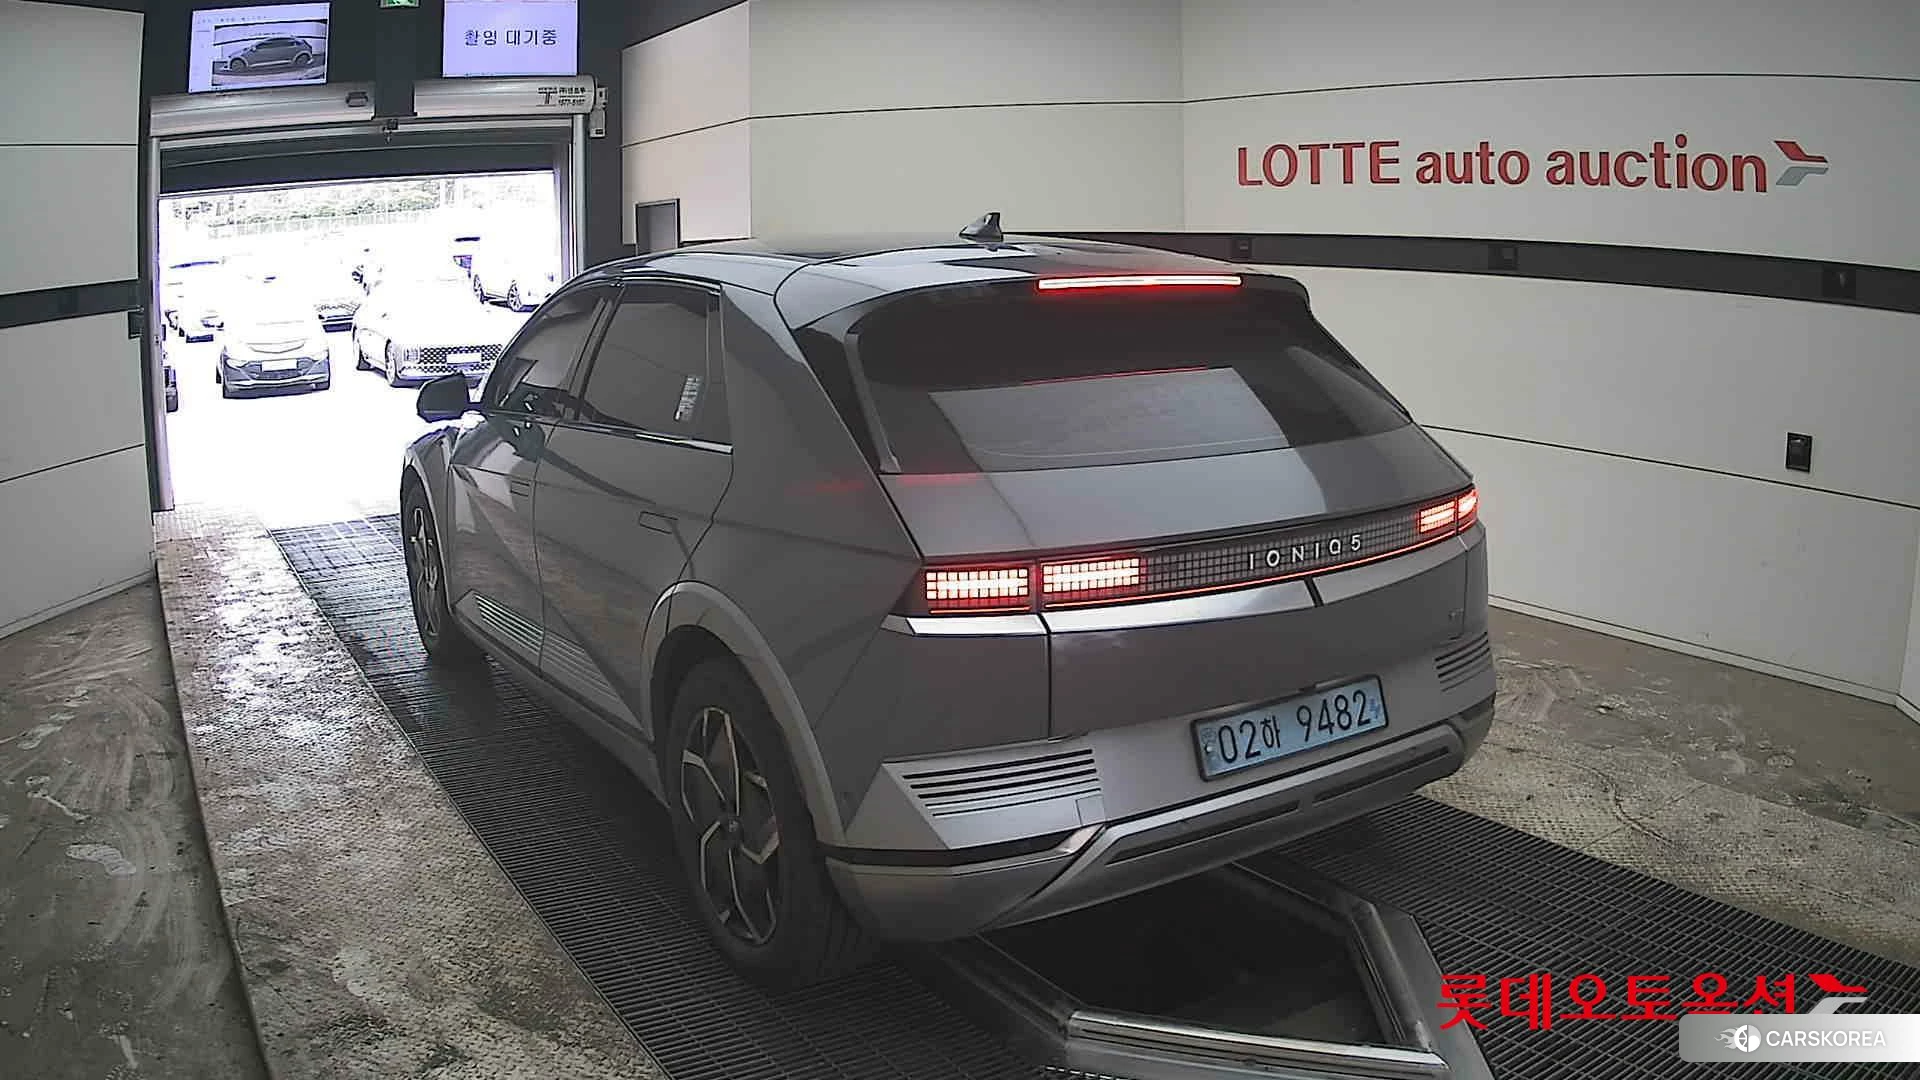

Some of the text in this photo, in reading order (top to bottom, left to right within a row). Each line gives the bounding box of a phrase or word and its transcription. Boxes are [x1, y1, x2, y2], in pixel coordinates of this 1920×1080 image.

[505, 29, 557, 46] 대기중
[1237, 134, 1768, 193] LOTTE auto auction
[1217, 689, 1372, 764] 02하 9482
